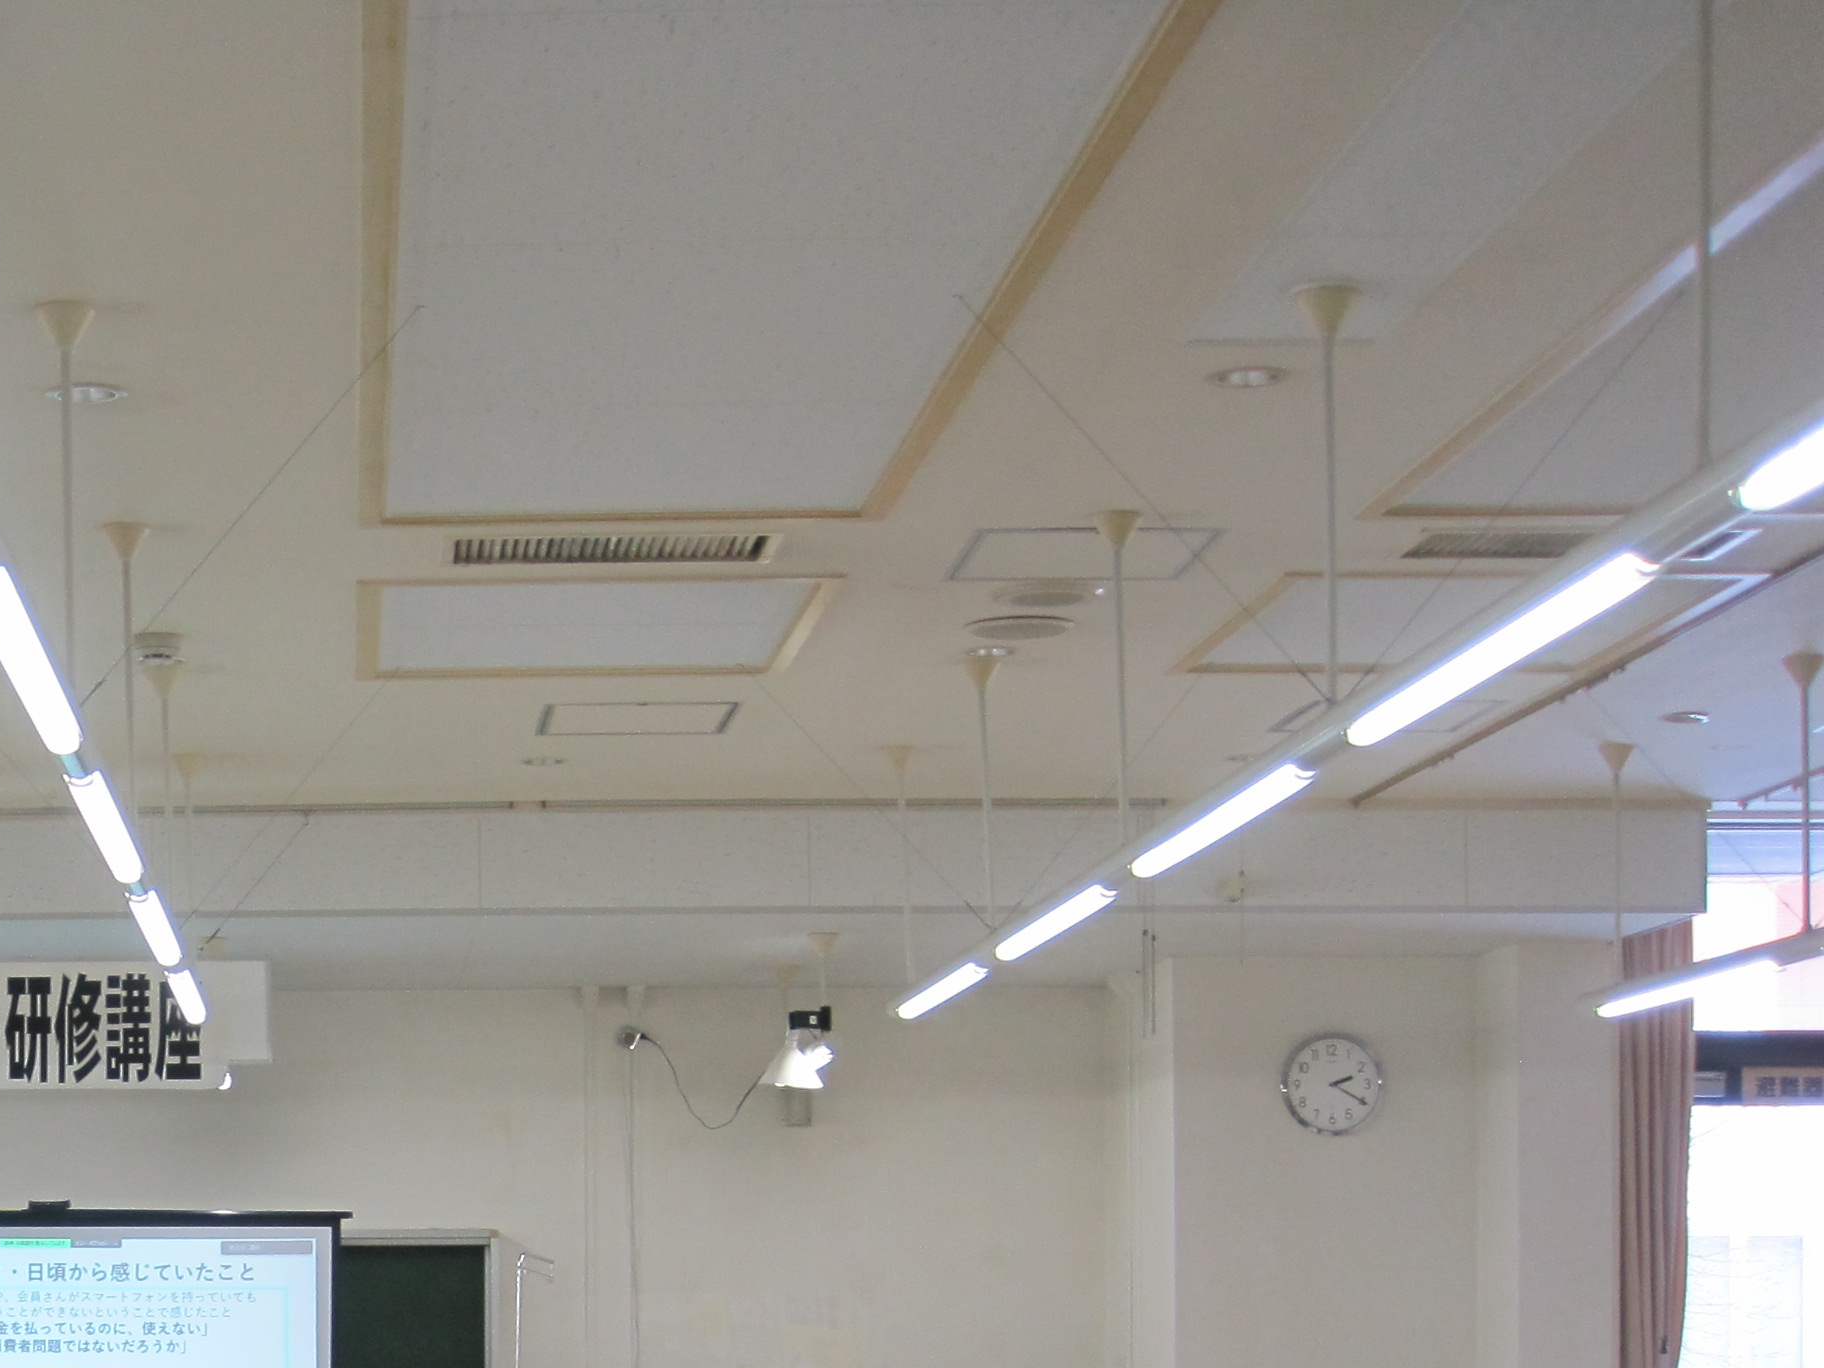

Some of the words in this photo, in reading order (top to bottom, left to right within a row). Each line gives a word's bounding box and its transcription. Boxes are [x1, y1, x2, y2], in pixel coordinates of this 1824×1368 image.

[1326, 1044, 1337, 1056] 12
[1299, 1062, 1309, 1074] 10
[1357, 1062, 1367, 1073] 2
[1294, 1079, 1301, 1090] 9
[1364, 1078, 1371, 1090] 3
[1298, 1096, 1306, 1108] 8
[1314, 1108, 1320, 1119] 7
[1329, 1113, 1336, 1125] 6
[1345, 1108, 1353, 1120] 5
